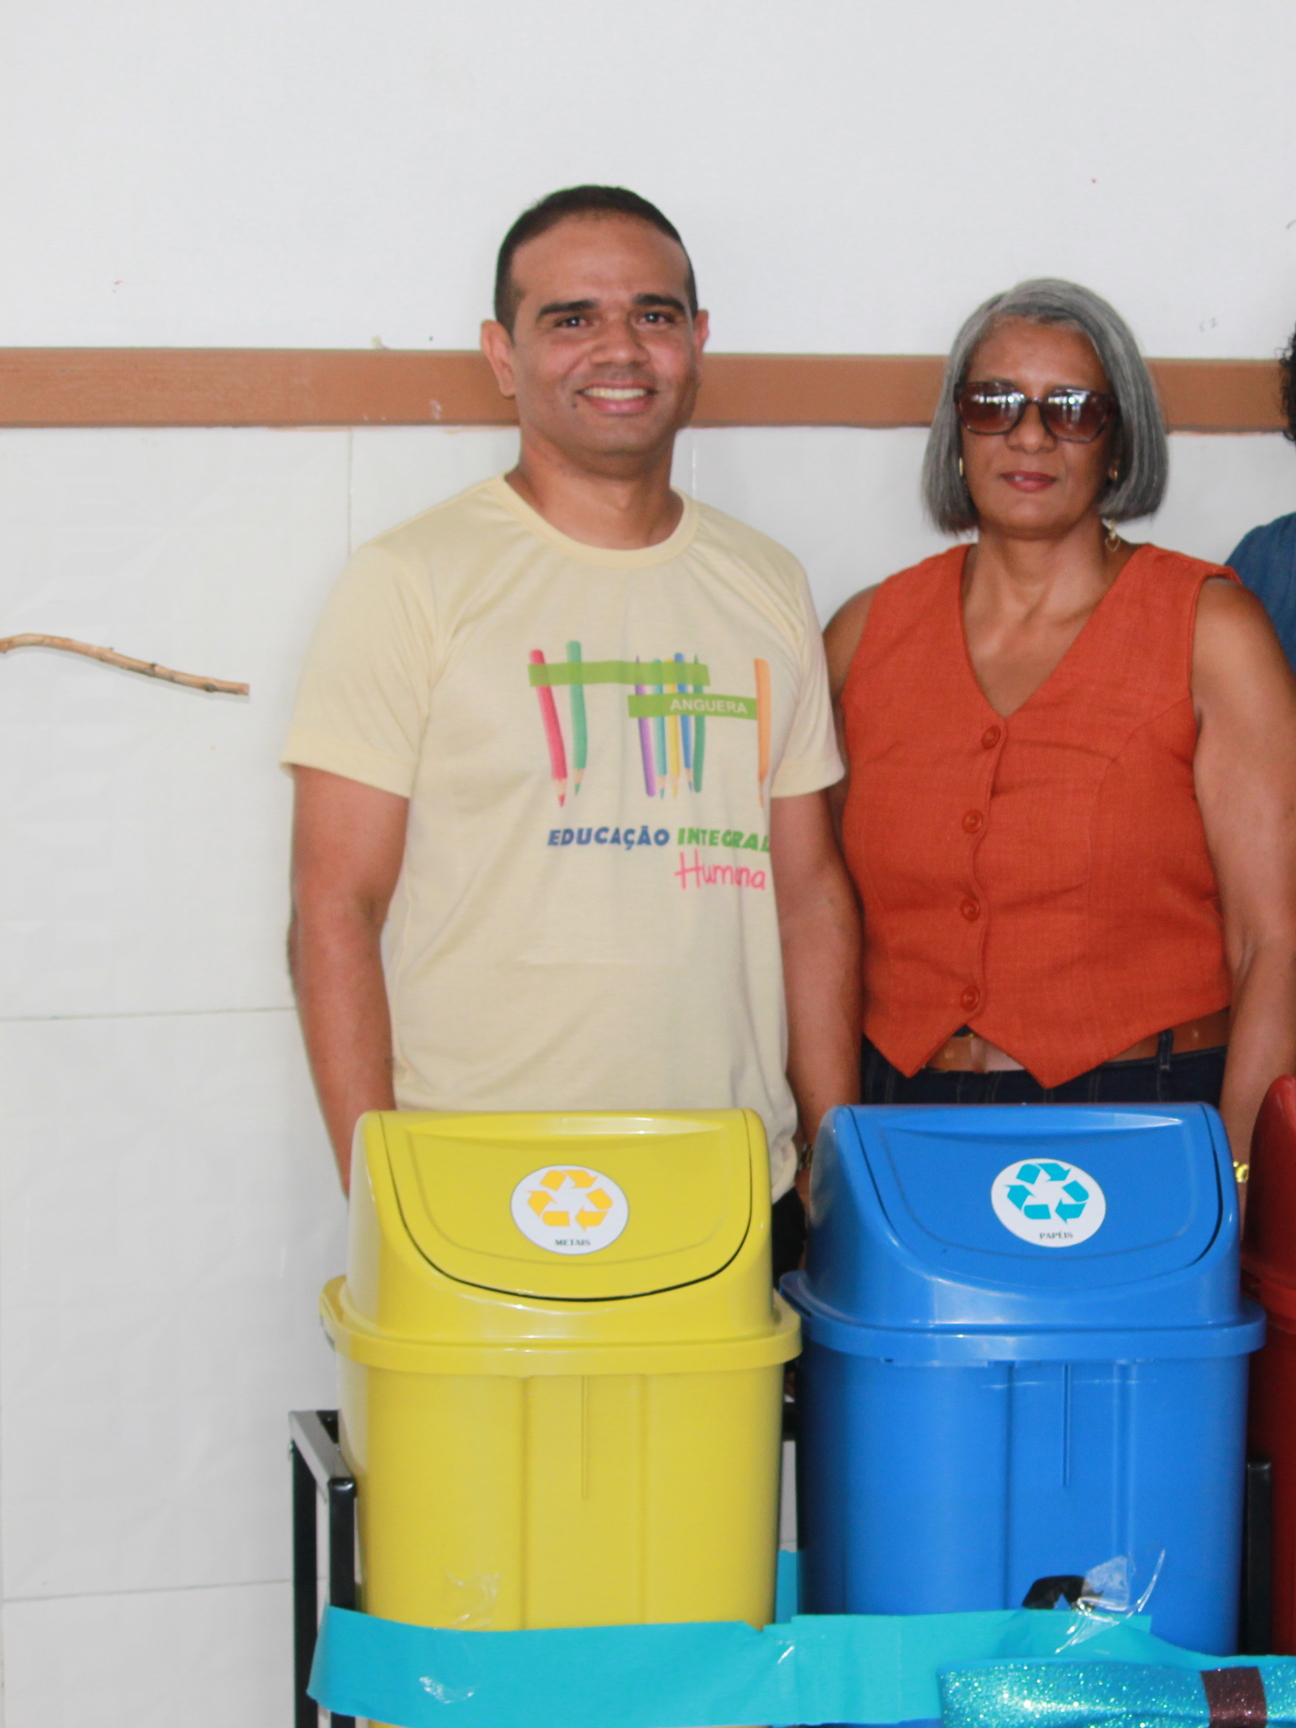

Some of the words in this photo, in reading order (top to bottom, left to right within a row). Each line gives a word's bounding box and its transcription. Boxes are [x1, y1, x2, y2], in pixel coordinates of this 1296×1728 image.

[669, 698, 748, 714] ANGUERA
[547, 826, 670, 851] EDUCAÇÃO
[677, 827, 770, 852] INTEGRAL
[1039, 1230, 1074, 1240] PAPÉIS
[554, 1239, 592, 1247] METAIS
